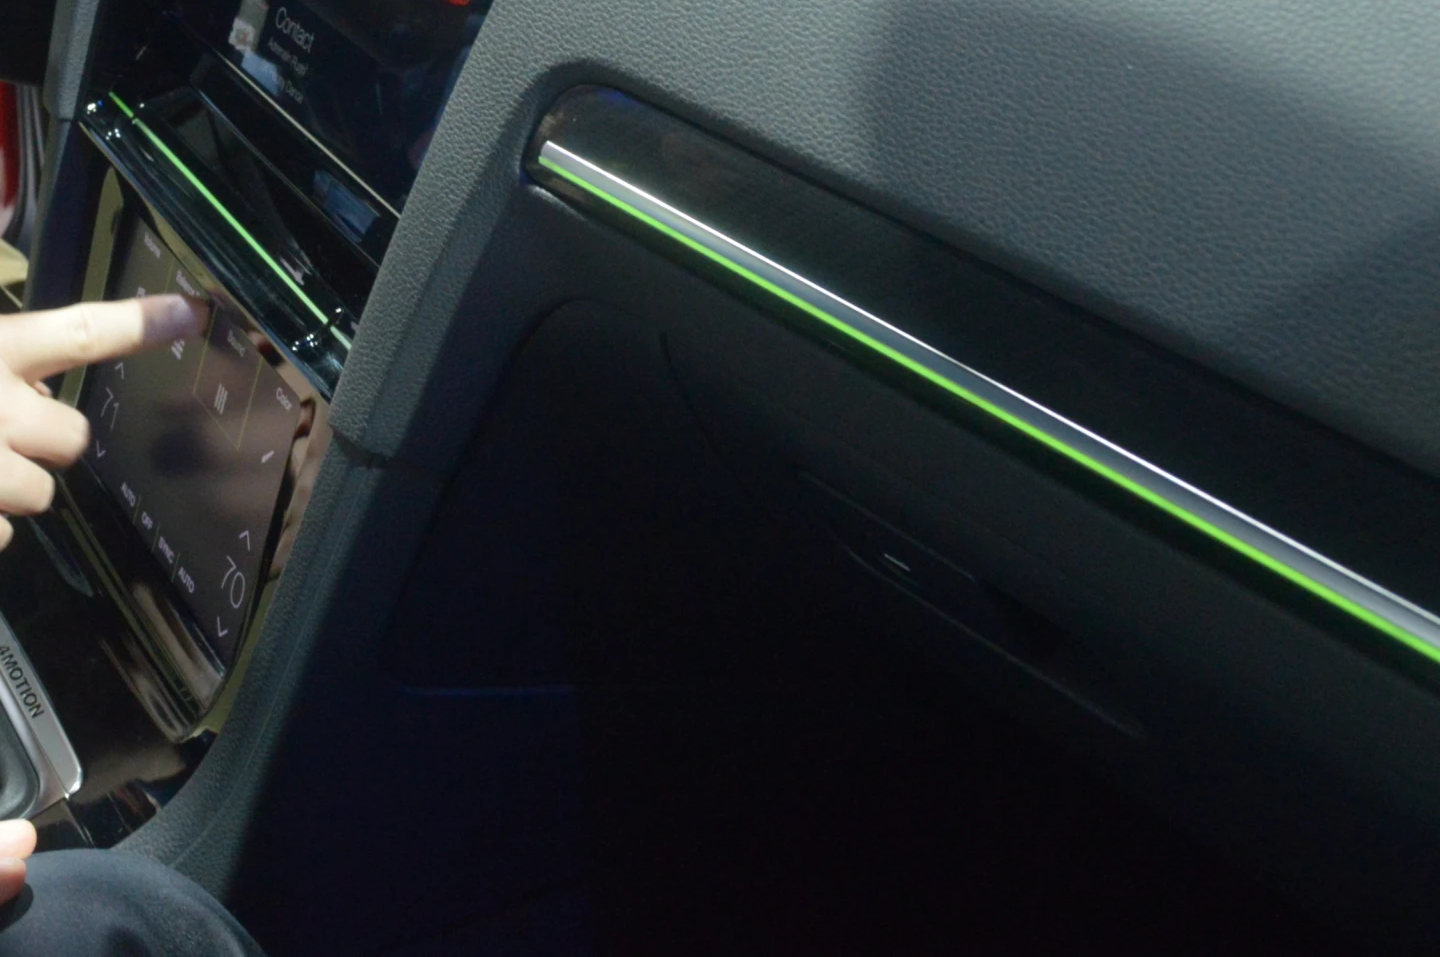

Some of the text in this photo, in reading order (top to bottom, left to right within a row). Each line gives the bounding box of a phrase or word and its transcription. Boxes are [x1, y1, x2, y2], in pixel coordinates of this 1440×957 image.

[275, 6, 315, 54] Contact
[100, 385, 119, 431] 71
[120, 481, 196, 594] AUTO OFF SYNC AUTO
[220, 554, 246, 610] 70
